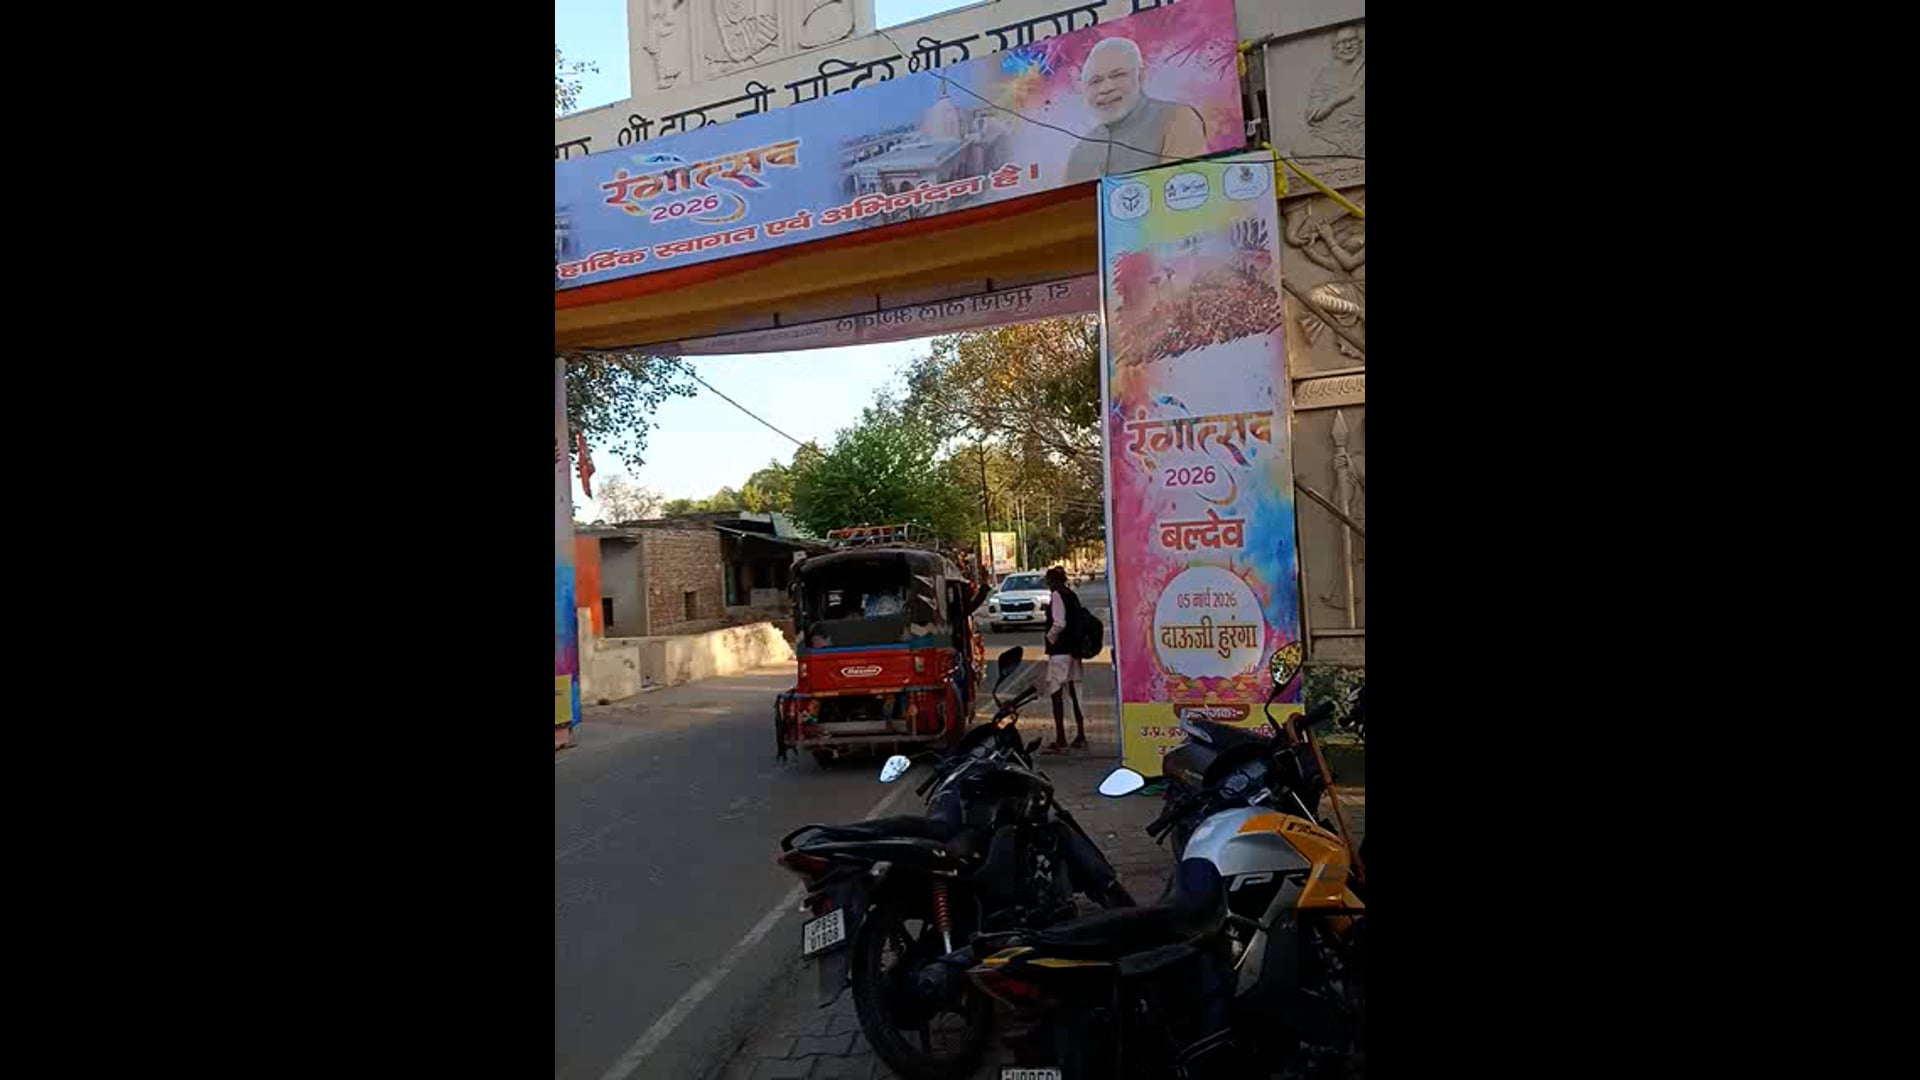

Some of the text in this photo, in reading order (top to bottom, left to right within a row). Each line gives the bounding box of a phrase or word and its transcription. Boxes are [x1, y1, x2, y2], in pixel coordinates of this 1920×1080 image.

[603, 140, 799, 214] रंगोत्सव
[558, 249, 646, 278] हार्दिक
[655, 225, 757, 259] स्वागत
[764, 212, 811, 238] एवं
[822, 174, 983, 226] अभिनंदन
[652, 195, 719, 221] 2026
[1126, 405, 1273, 472] रंगोत्सव
[1165, 466, 1217, 487] 2026
[1160, 508, 1245, 550] बल्देव
[1177, 592, 1190, 608] 05
[1213, 592, 1238, 608] 2026
[1160, 615, 1258, 659] दाऊजी हुरंगा
